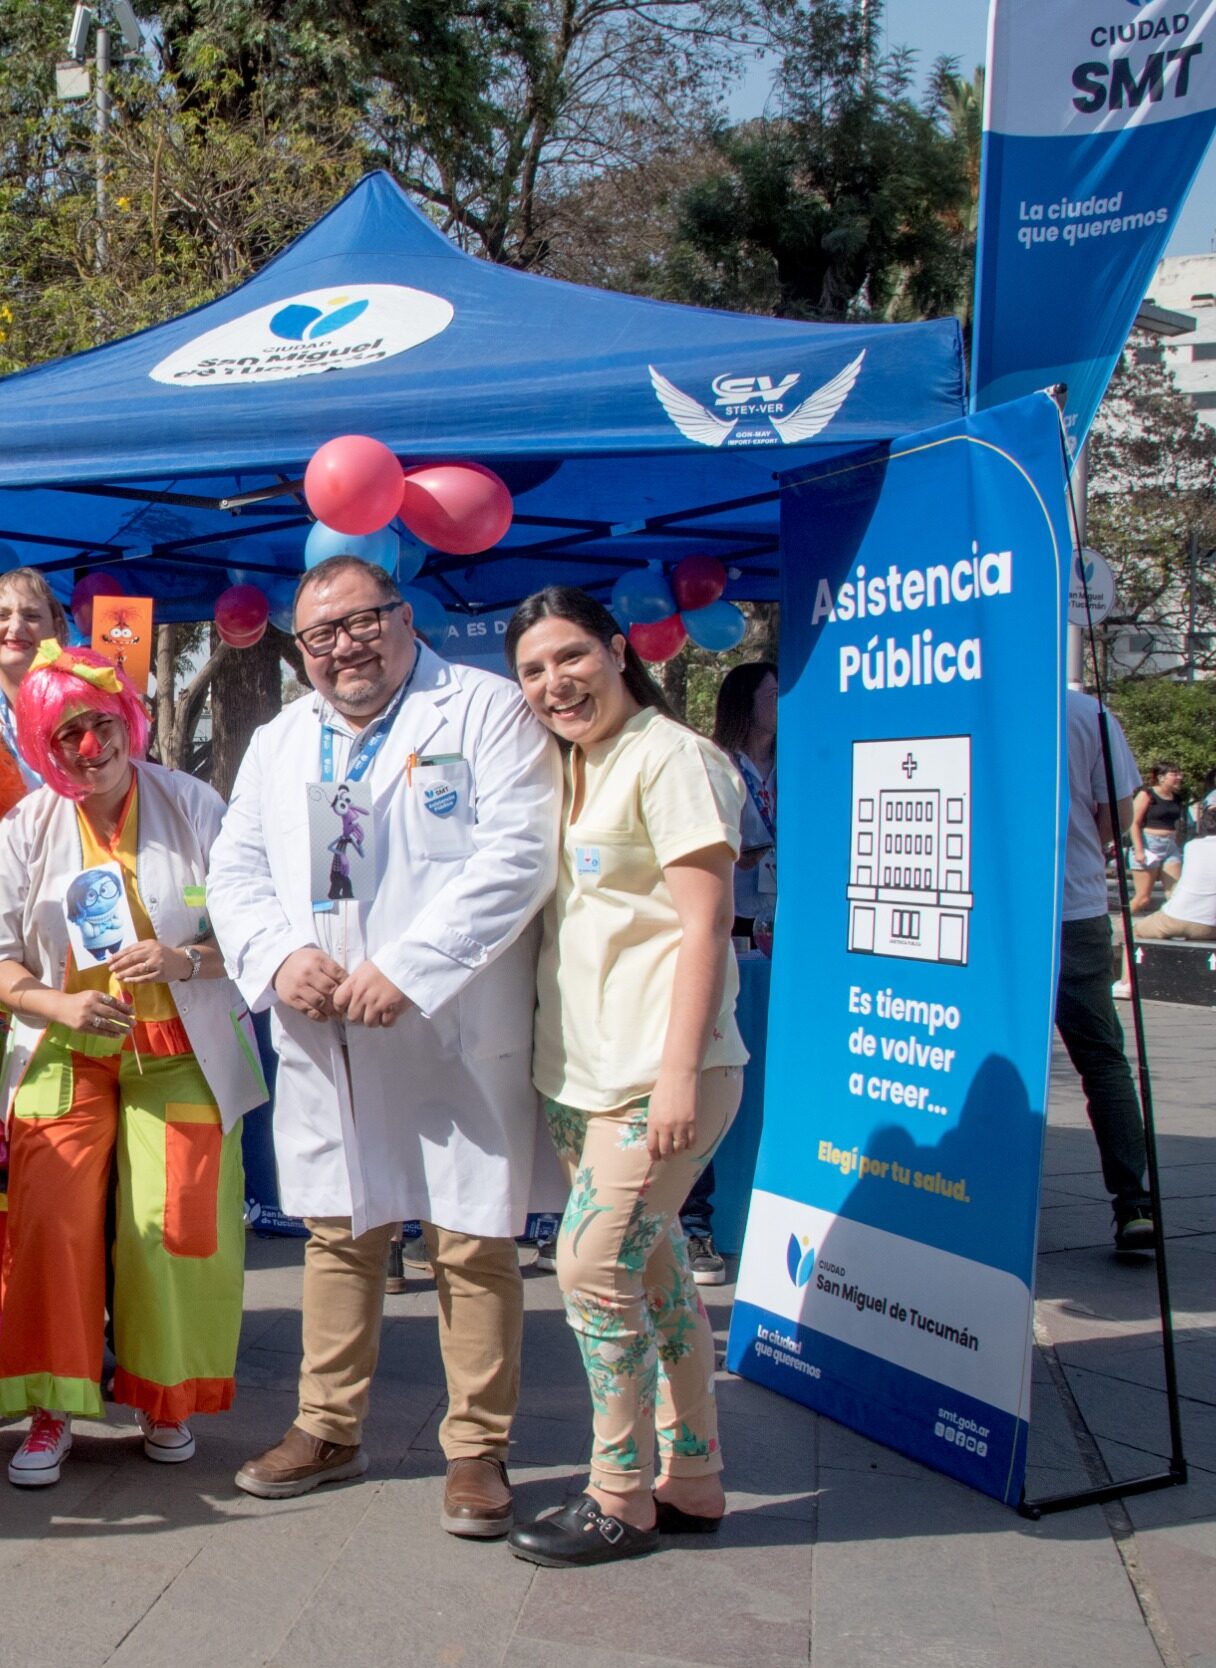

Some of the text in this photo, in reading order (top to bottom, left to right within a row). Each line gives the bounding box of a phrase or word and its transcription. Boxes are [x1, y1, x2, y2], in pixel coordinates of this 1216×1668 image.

[1090, 13, 1189, 47] CIUDAD
[1071, 42, 1203, 114] SMT
[1019, 191, 1123, 221] La ciudad
[1017, 207, 1168, 250] que queremos
[198, 338, 384, 368] San Miguel
[262, 340, 332, 353] CIUDAD
[725, 403, 784, 416] STEY-VER
[811, 541, 1012, 625] Asistencia
[1079, 591, 1104, 602] Mguel
[467, 622, 487, 637] ES
[839, 628, 982, 692] Pública
[848, 985, 961, 1036] Es tiempo
[848, 1026, 955, 1073] de volver
[848, 1072, 948, 1116] a creer...
[818, 1140, 971, 1203] Elegí por tu salud.
[818, 1259, 846, 1277] CIUDAD
[816, 1273, 979, 1352] San Miguel de Tucumán
[757, 1324, 802, 1355] La ciudad
[755, 1341, 821, 1380] que queremos
[937, 1408, 991, 1439] smt.gob.ar
